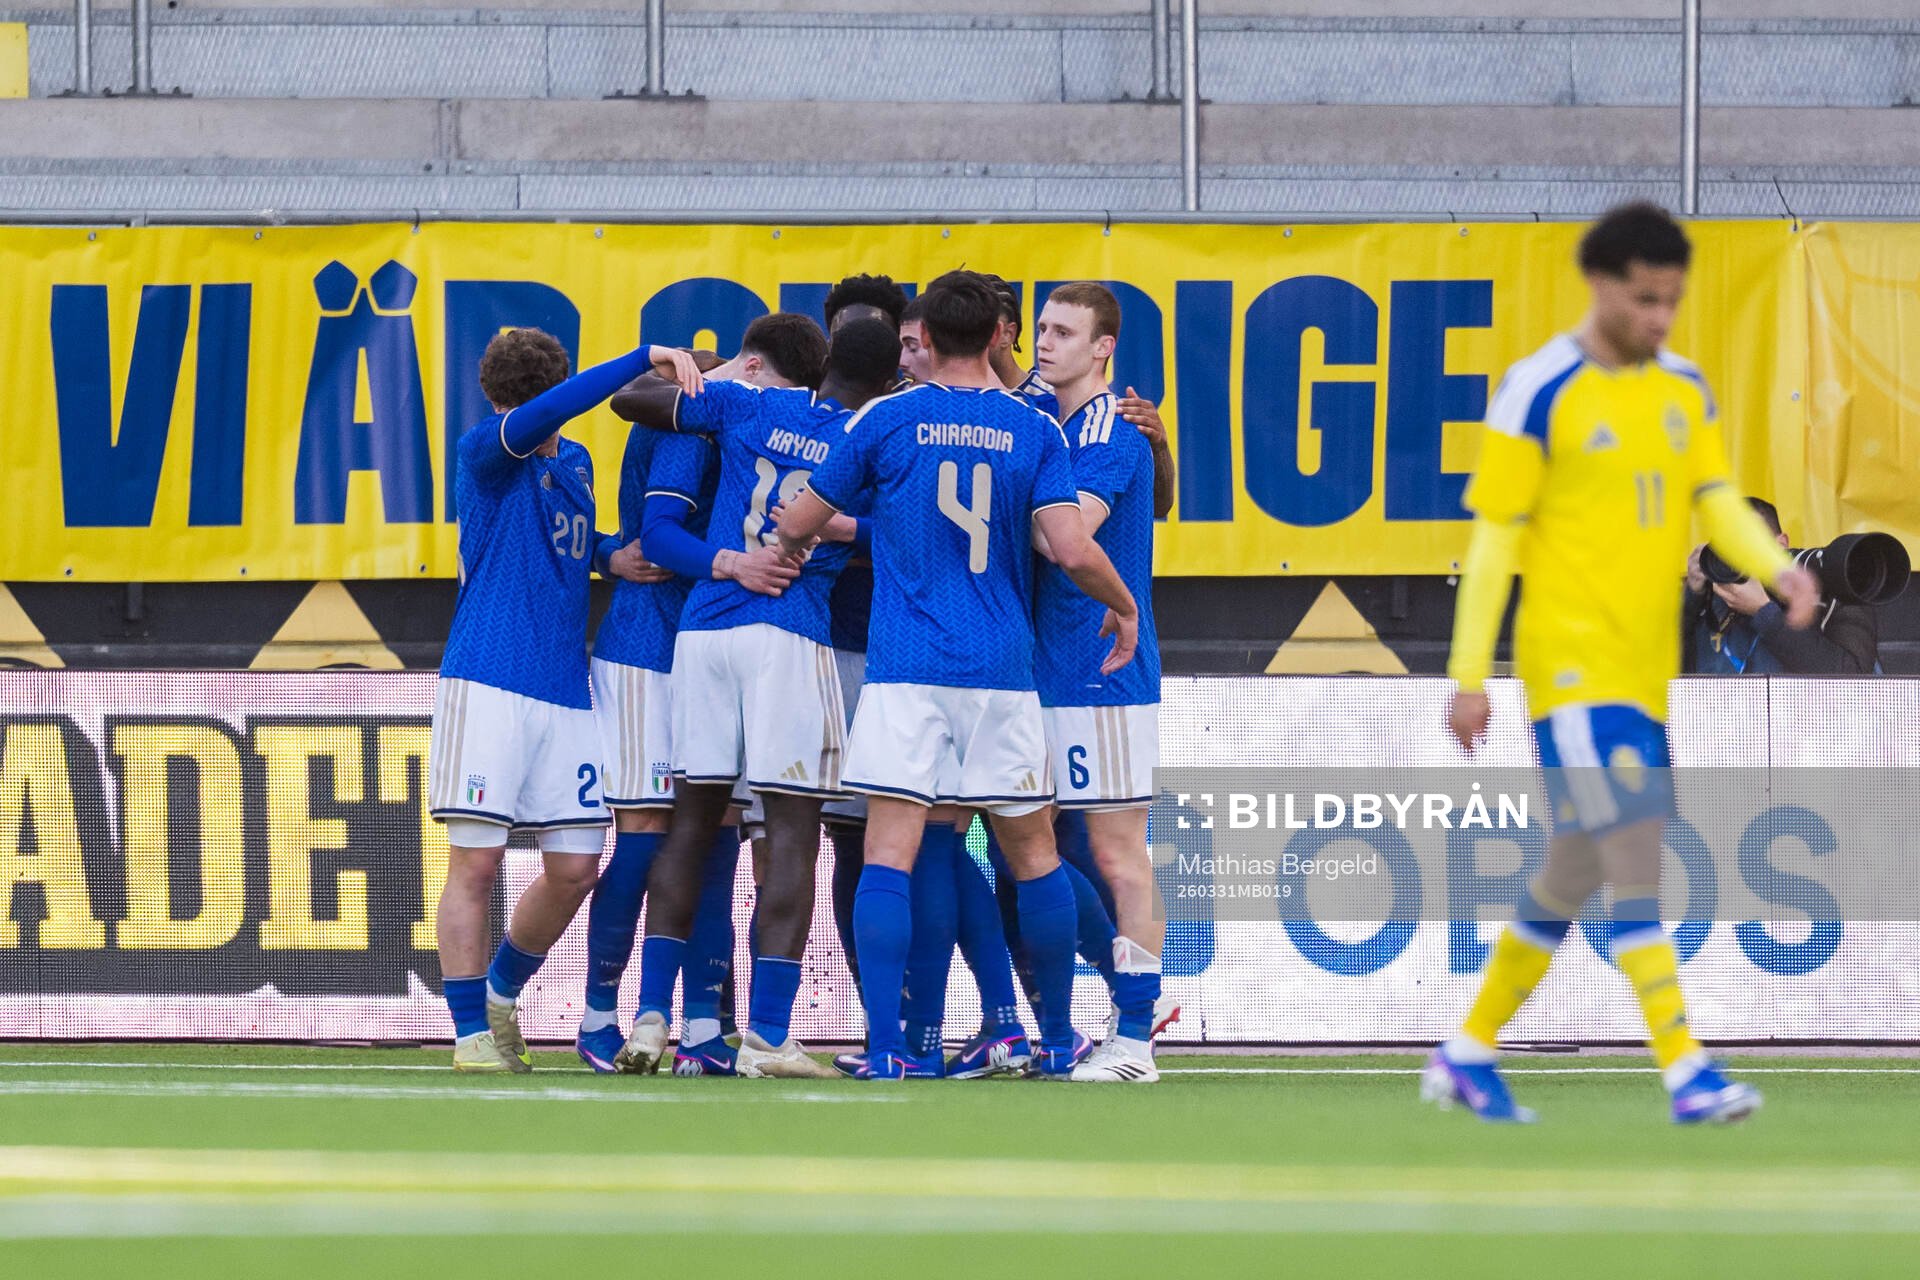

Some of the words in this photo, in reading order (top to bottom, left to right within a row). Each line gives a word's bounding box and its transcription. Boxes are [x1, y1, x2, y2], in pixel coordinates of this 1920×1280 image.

[50, 282, 253, 528] VI
[916, 422, 1014, 454] CHIARODIA
[938, 461, 992, 574] 4
[1633, 470, 1665, 531] 11
[552, 511, 588, 560] 20
[577, 762, 604, 808] 2
[1068, 744, 1090, 790] 6
